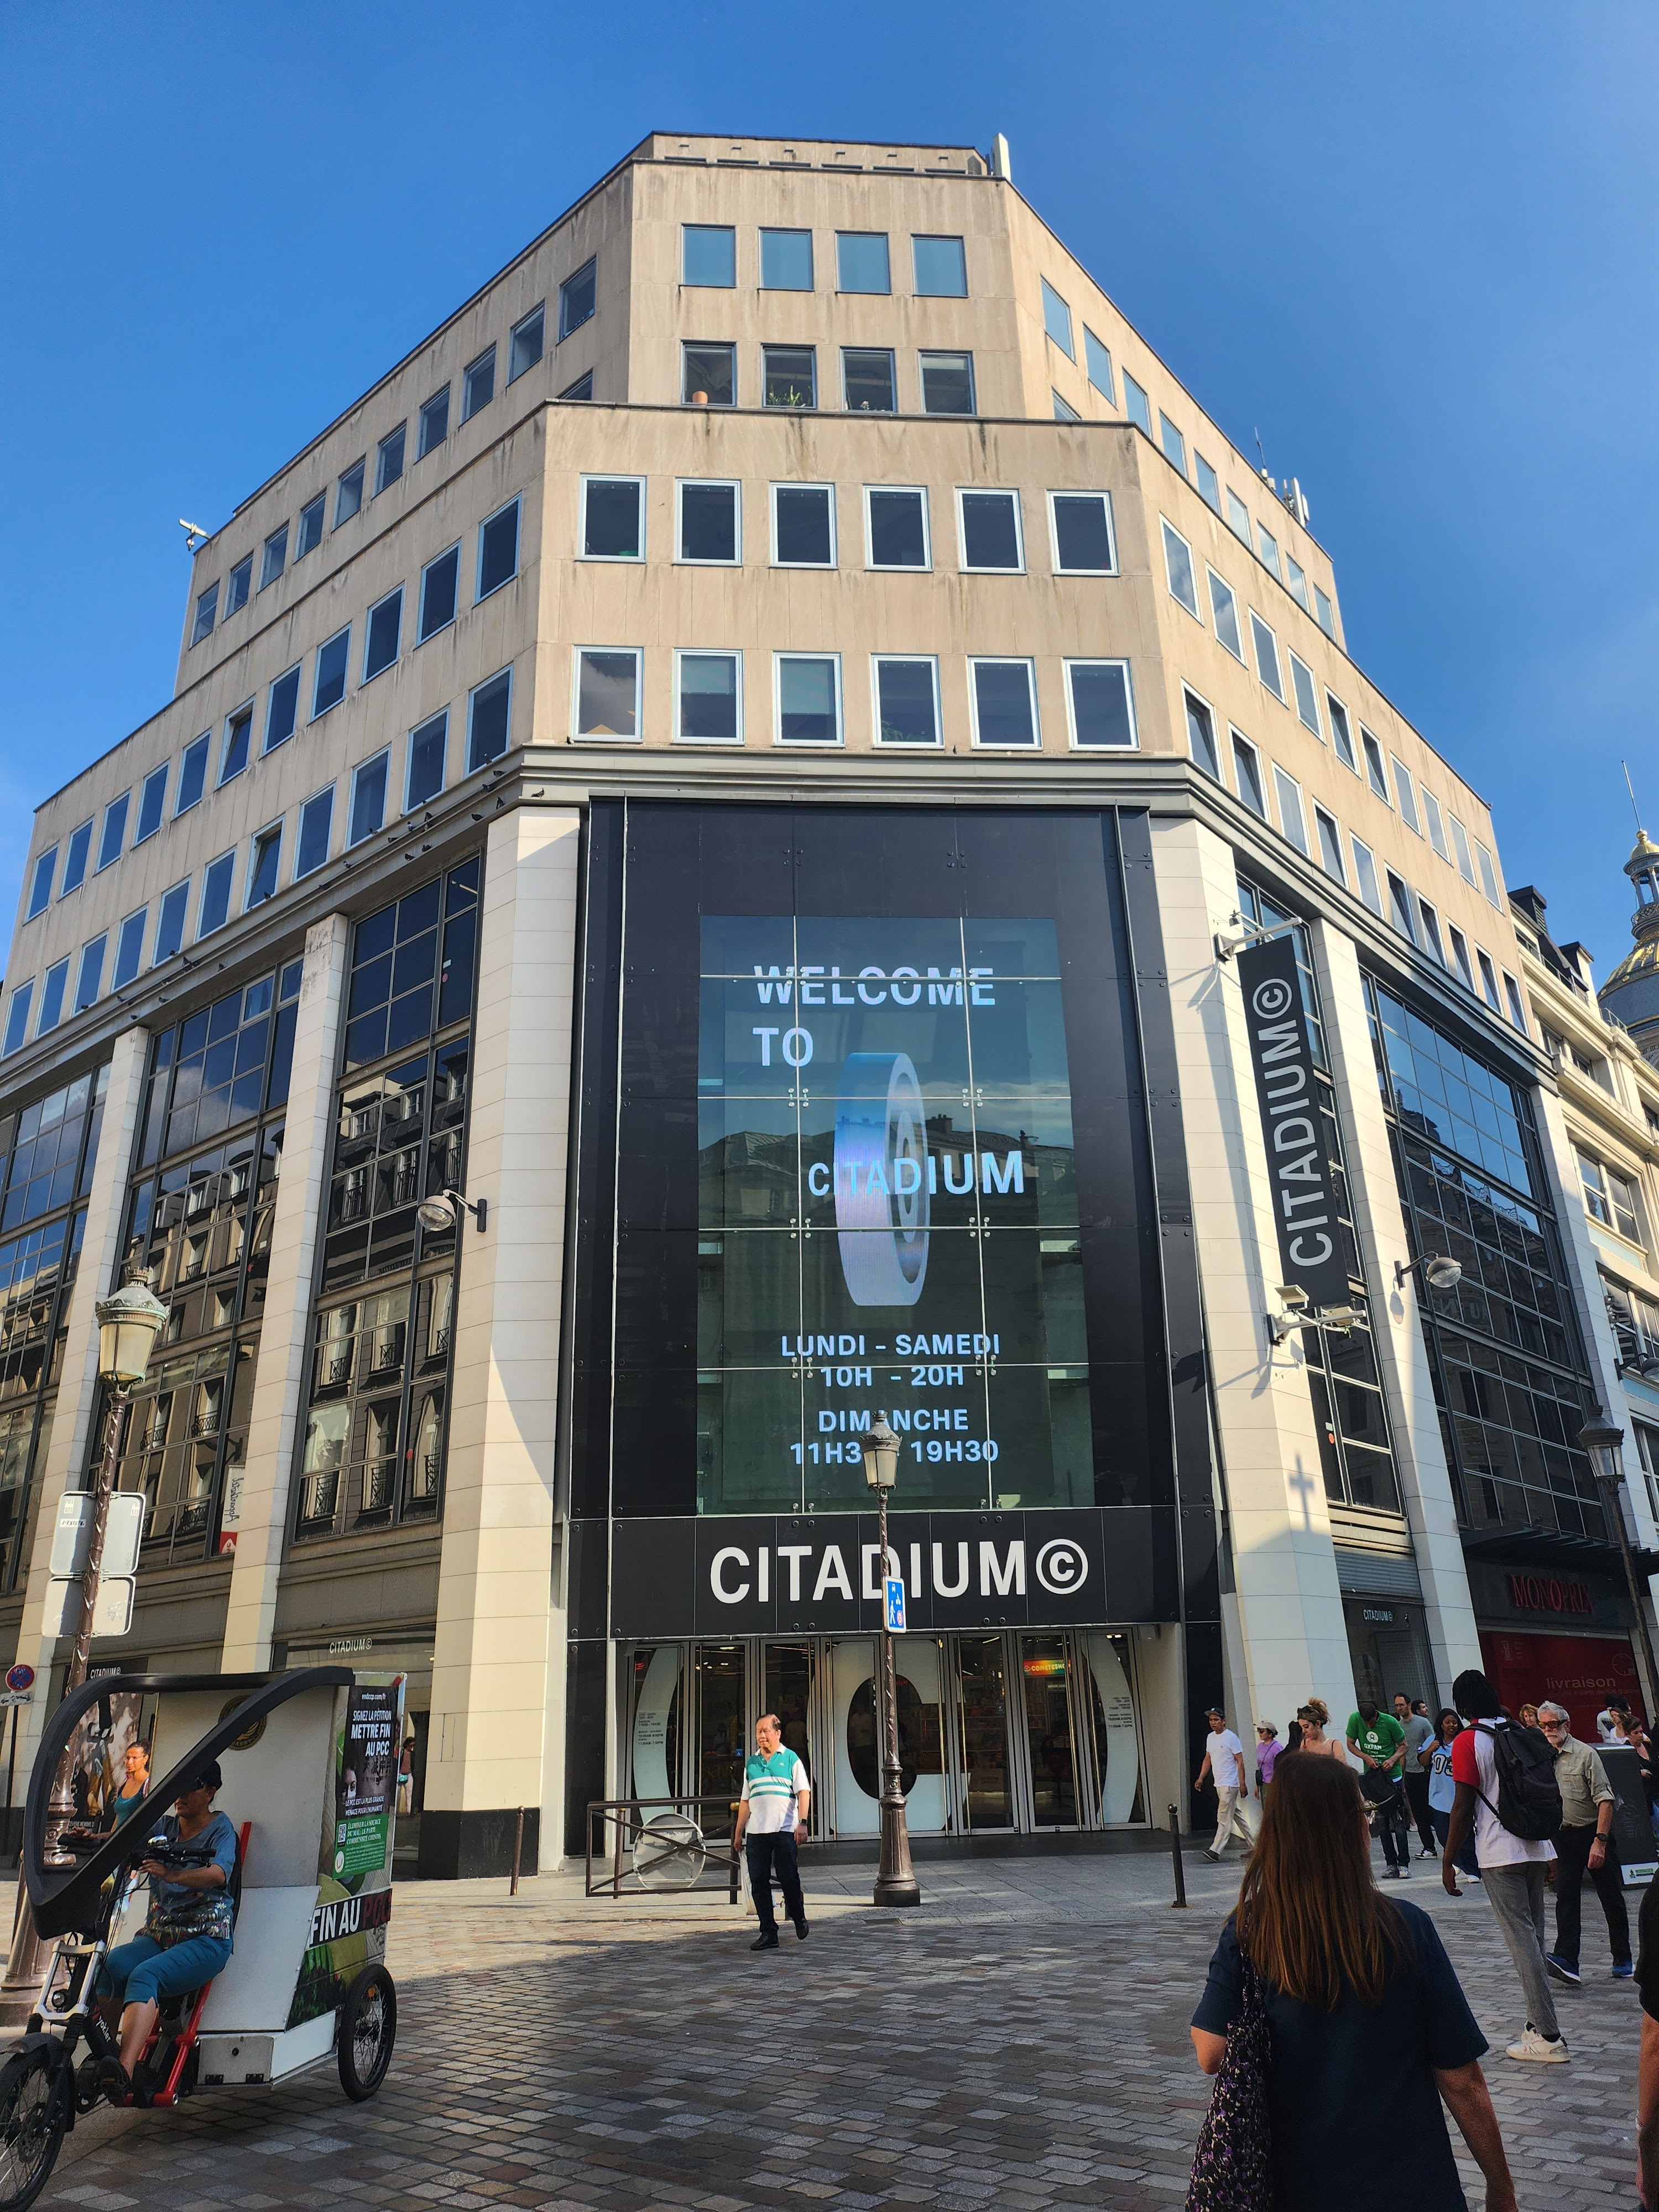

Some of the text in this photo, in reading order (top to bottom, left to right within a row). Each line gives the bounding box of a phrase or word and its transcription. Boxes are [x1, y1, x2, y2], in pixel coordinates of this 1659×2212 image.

[754, 965, 995, 1005] WELCOME
[752, 1027, 814, 1067] TO
[808, 1150, 1024, 1197] CITADIUM
[781, 1334, 865, 1357] LUNDI
[895, 1333, 1000, 1356] SAMEDI
[820, 1366, 873, 1387] 10H
[911, 1365, 964, 1387] 20H
[790, 1439, 999, 1465] 11H3 19H30
[1509, 1574, 1595, 1614] MONOPRIX
[1546, 1677, 1616, 1689] livraison
[352, 1708, 392, 1721] SIGNEZ LA PÉTITION
[351, 1723, 391, 1739] METTRE FIN
[365, 1740, 390, 1757] AU PCC
[373, 1795, 384, 1803] GRANDE
[309, 1889, 392, 1945] FIN AU PCC
